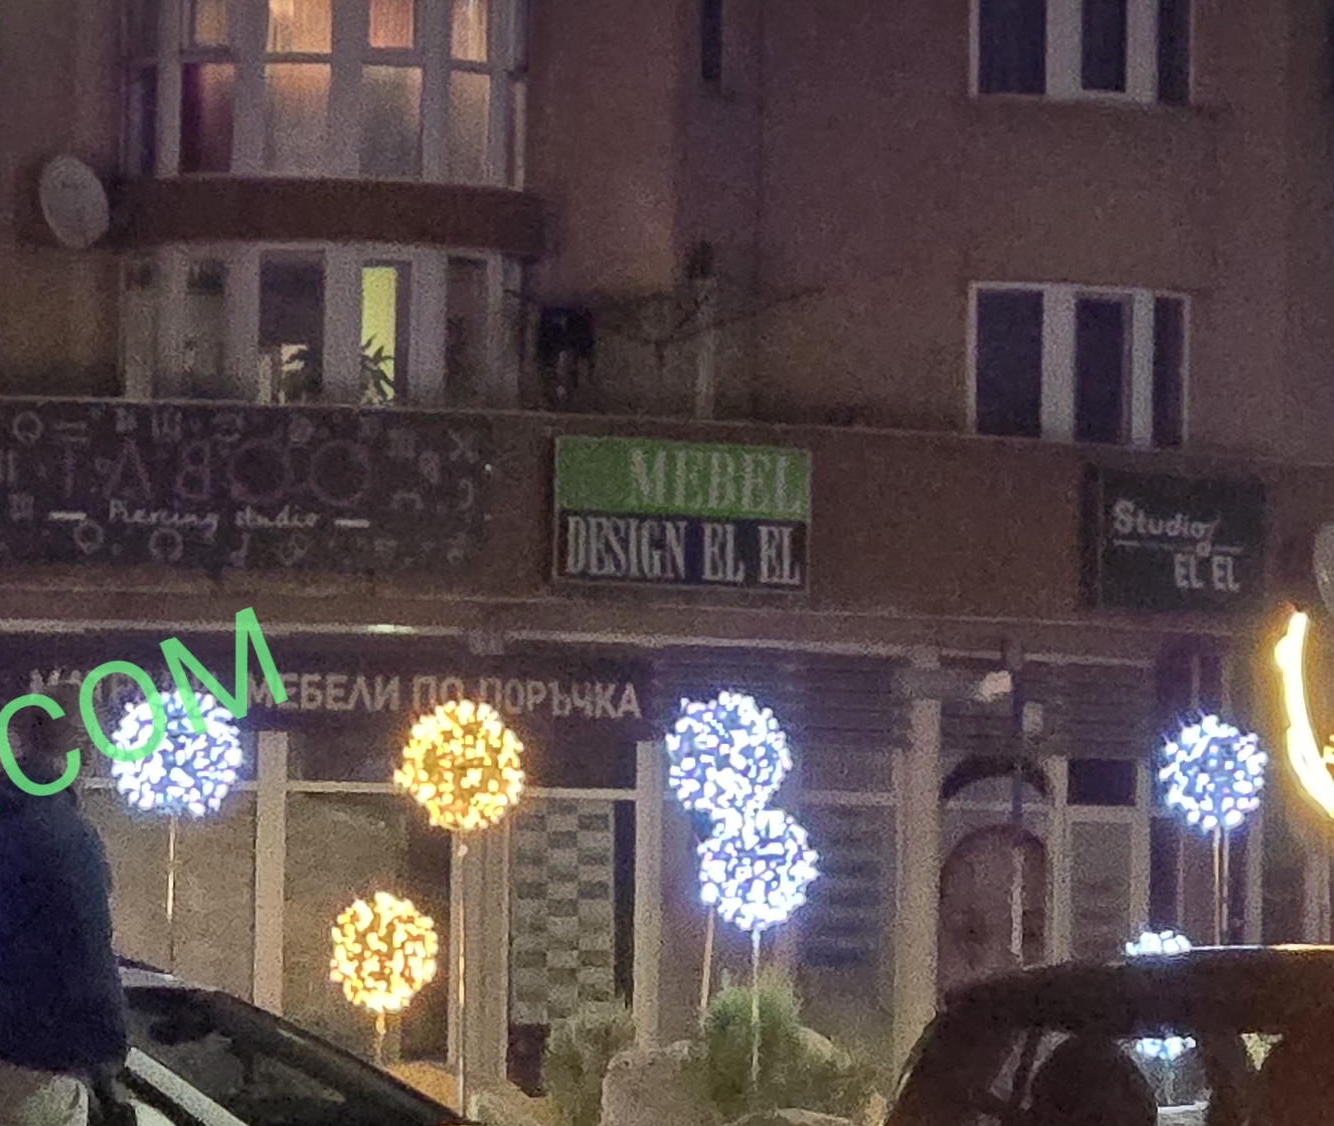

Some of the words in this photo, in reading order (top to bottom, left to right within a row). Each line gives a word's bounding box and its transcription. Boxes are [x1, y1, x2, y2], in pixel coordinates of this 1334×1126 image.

[630, 449, 801, 511] MEBEL
[108, 499, 218, 530] Piercing
[1113, 499, 1208, 538] Studio
[566, 516, 688, 579] DESIGN
[701, 523, 745, 583] EL
[758, 526, 800, 586] EL
[1174, 553, 1205, 589] EL
[1212, 556, 1242, 593] EL
[247, 672, 401, 713] МЕБЕЛИ
[412, 675, 467, 706] ПО
[478, 677, 641, 719] ПОРЪЧКА
